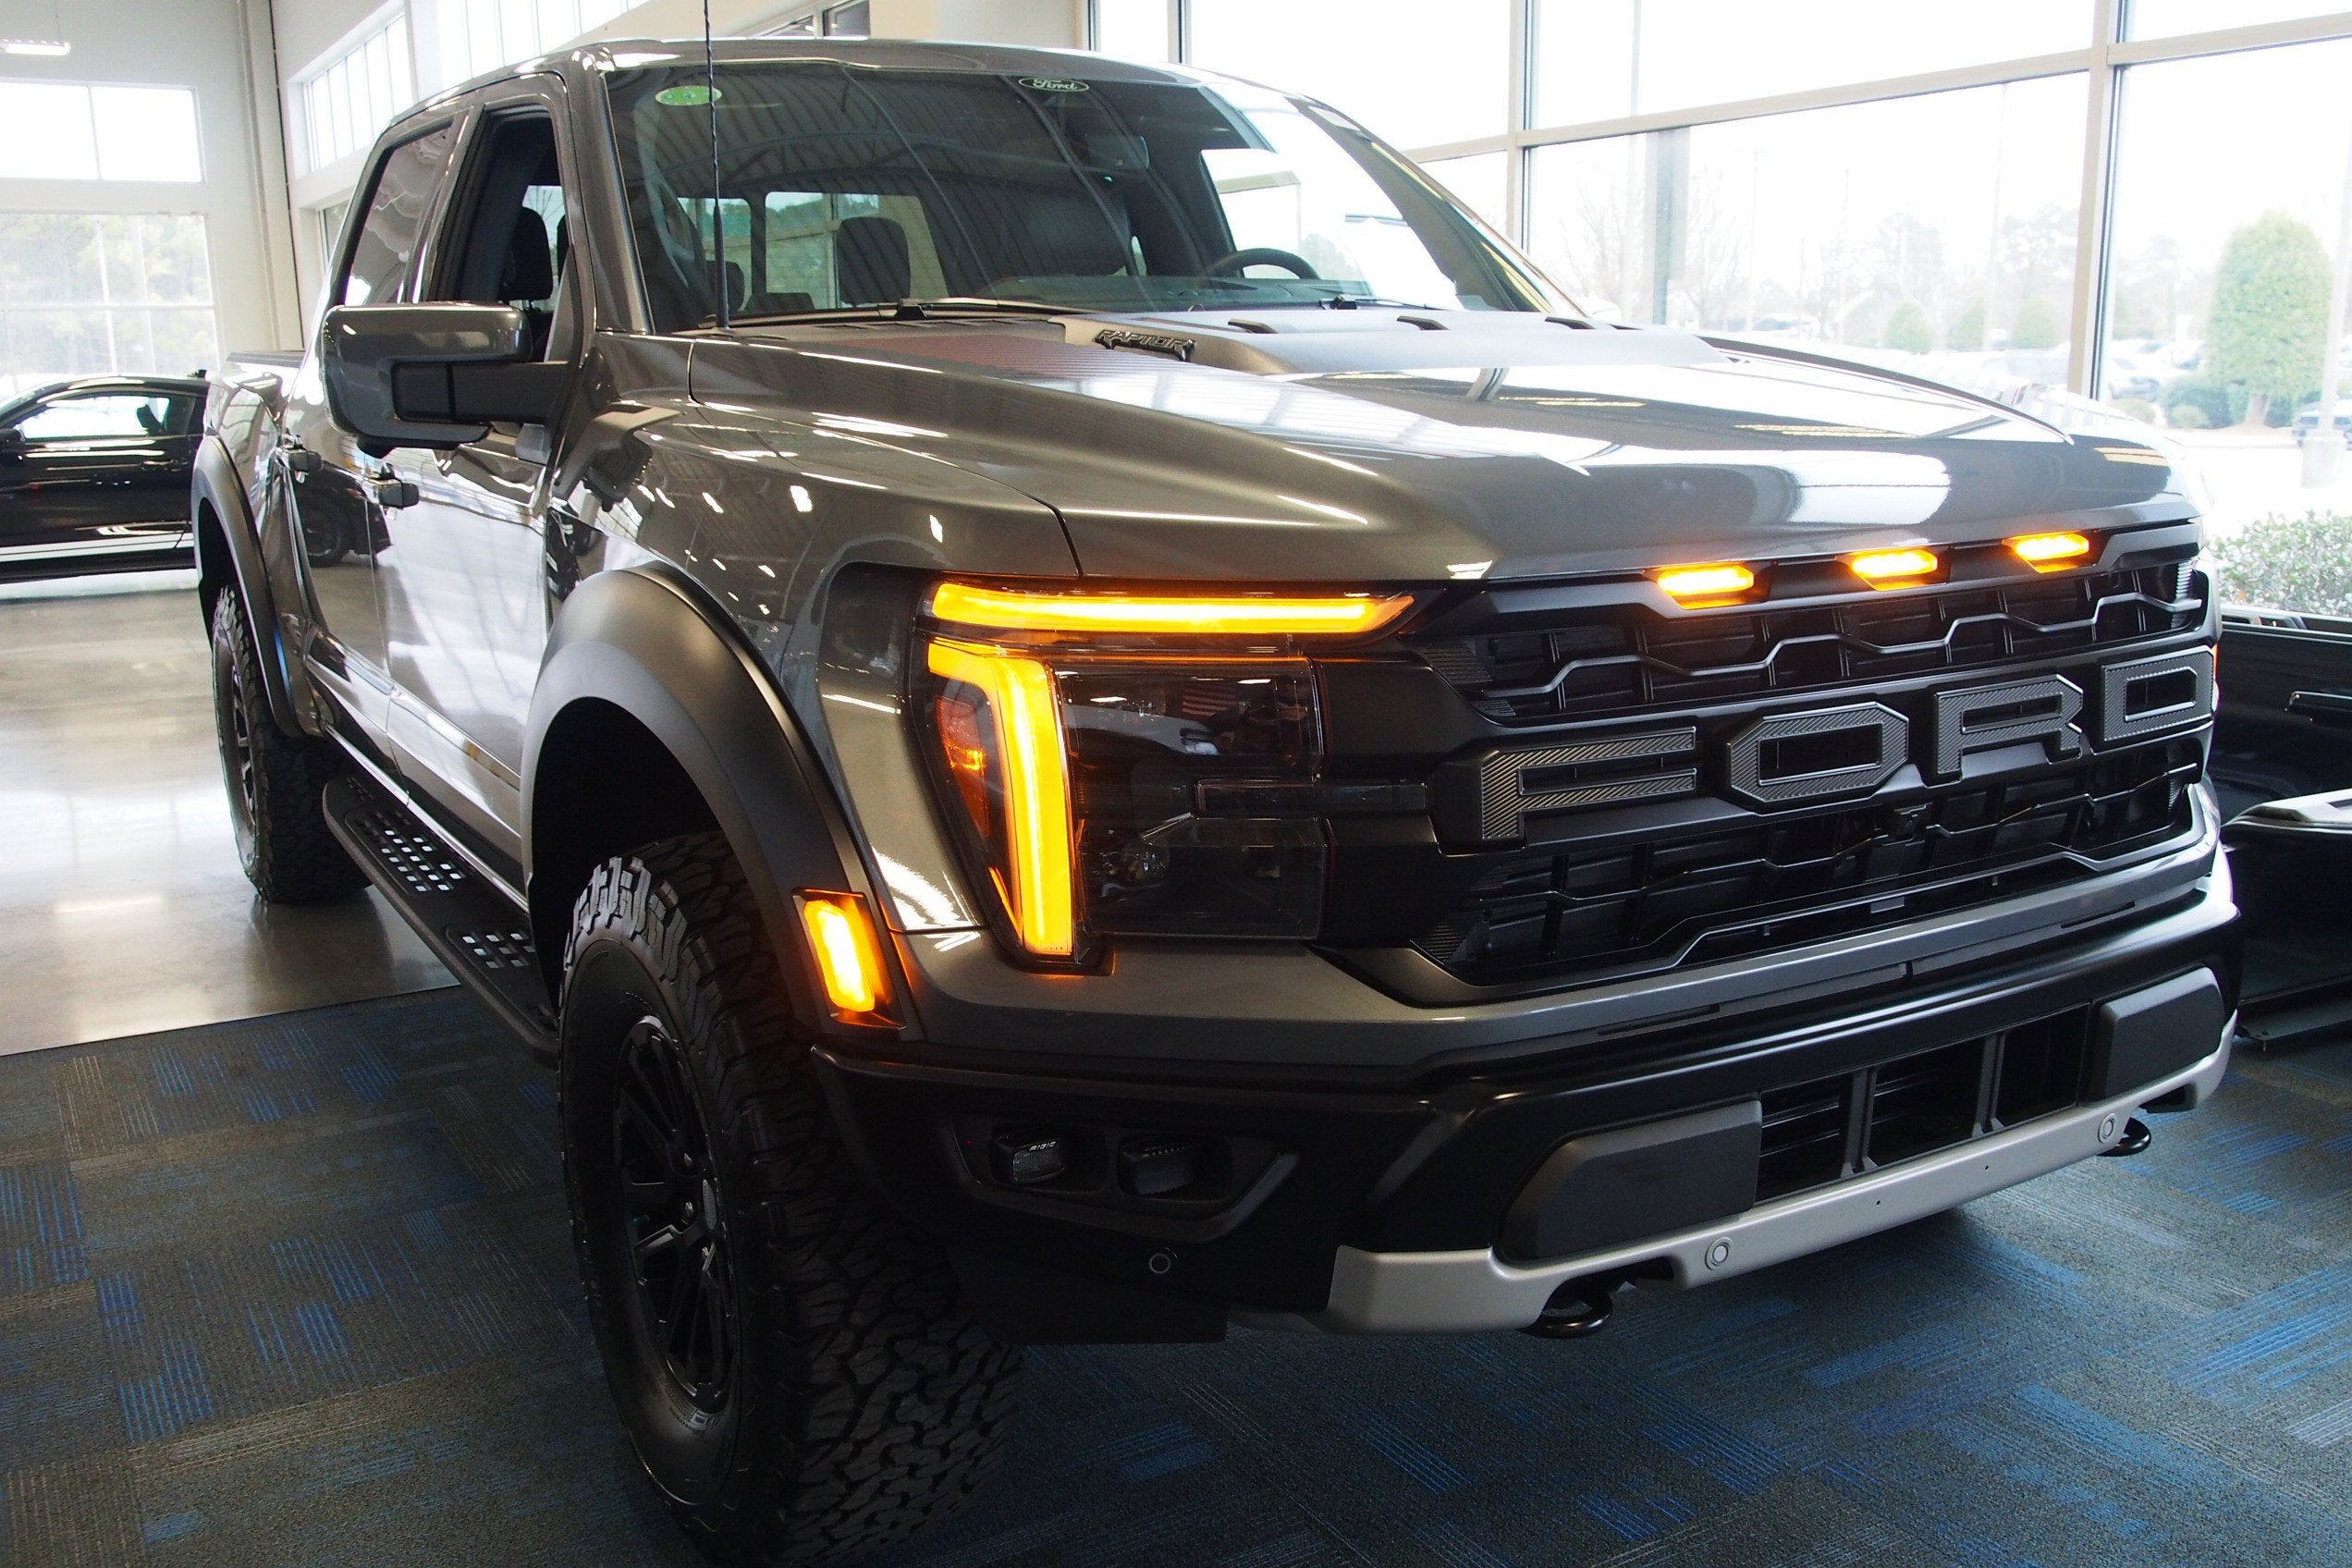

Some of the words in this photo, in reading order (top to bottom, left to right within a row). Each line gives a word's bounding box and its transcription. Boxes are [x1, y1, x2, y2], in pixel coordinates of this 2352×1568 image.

[1032, 79, 1078, 90] Ford
[1095, 329, 1194, 361] RAPTOR
[1481, 646, 2215, 840] FORD
